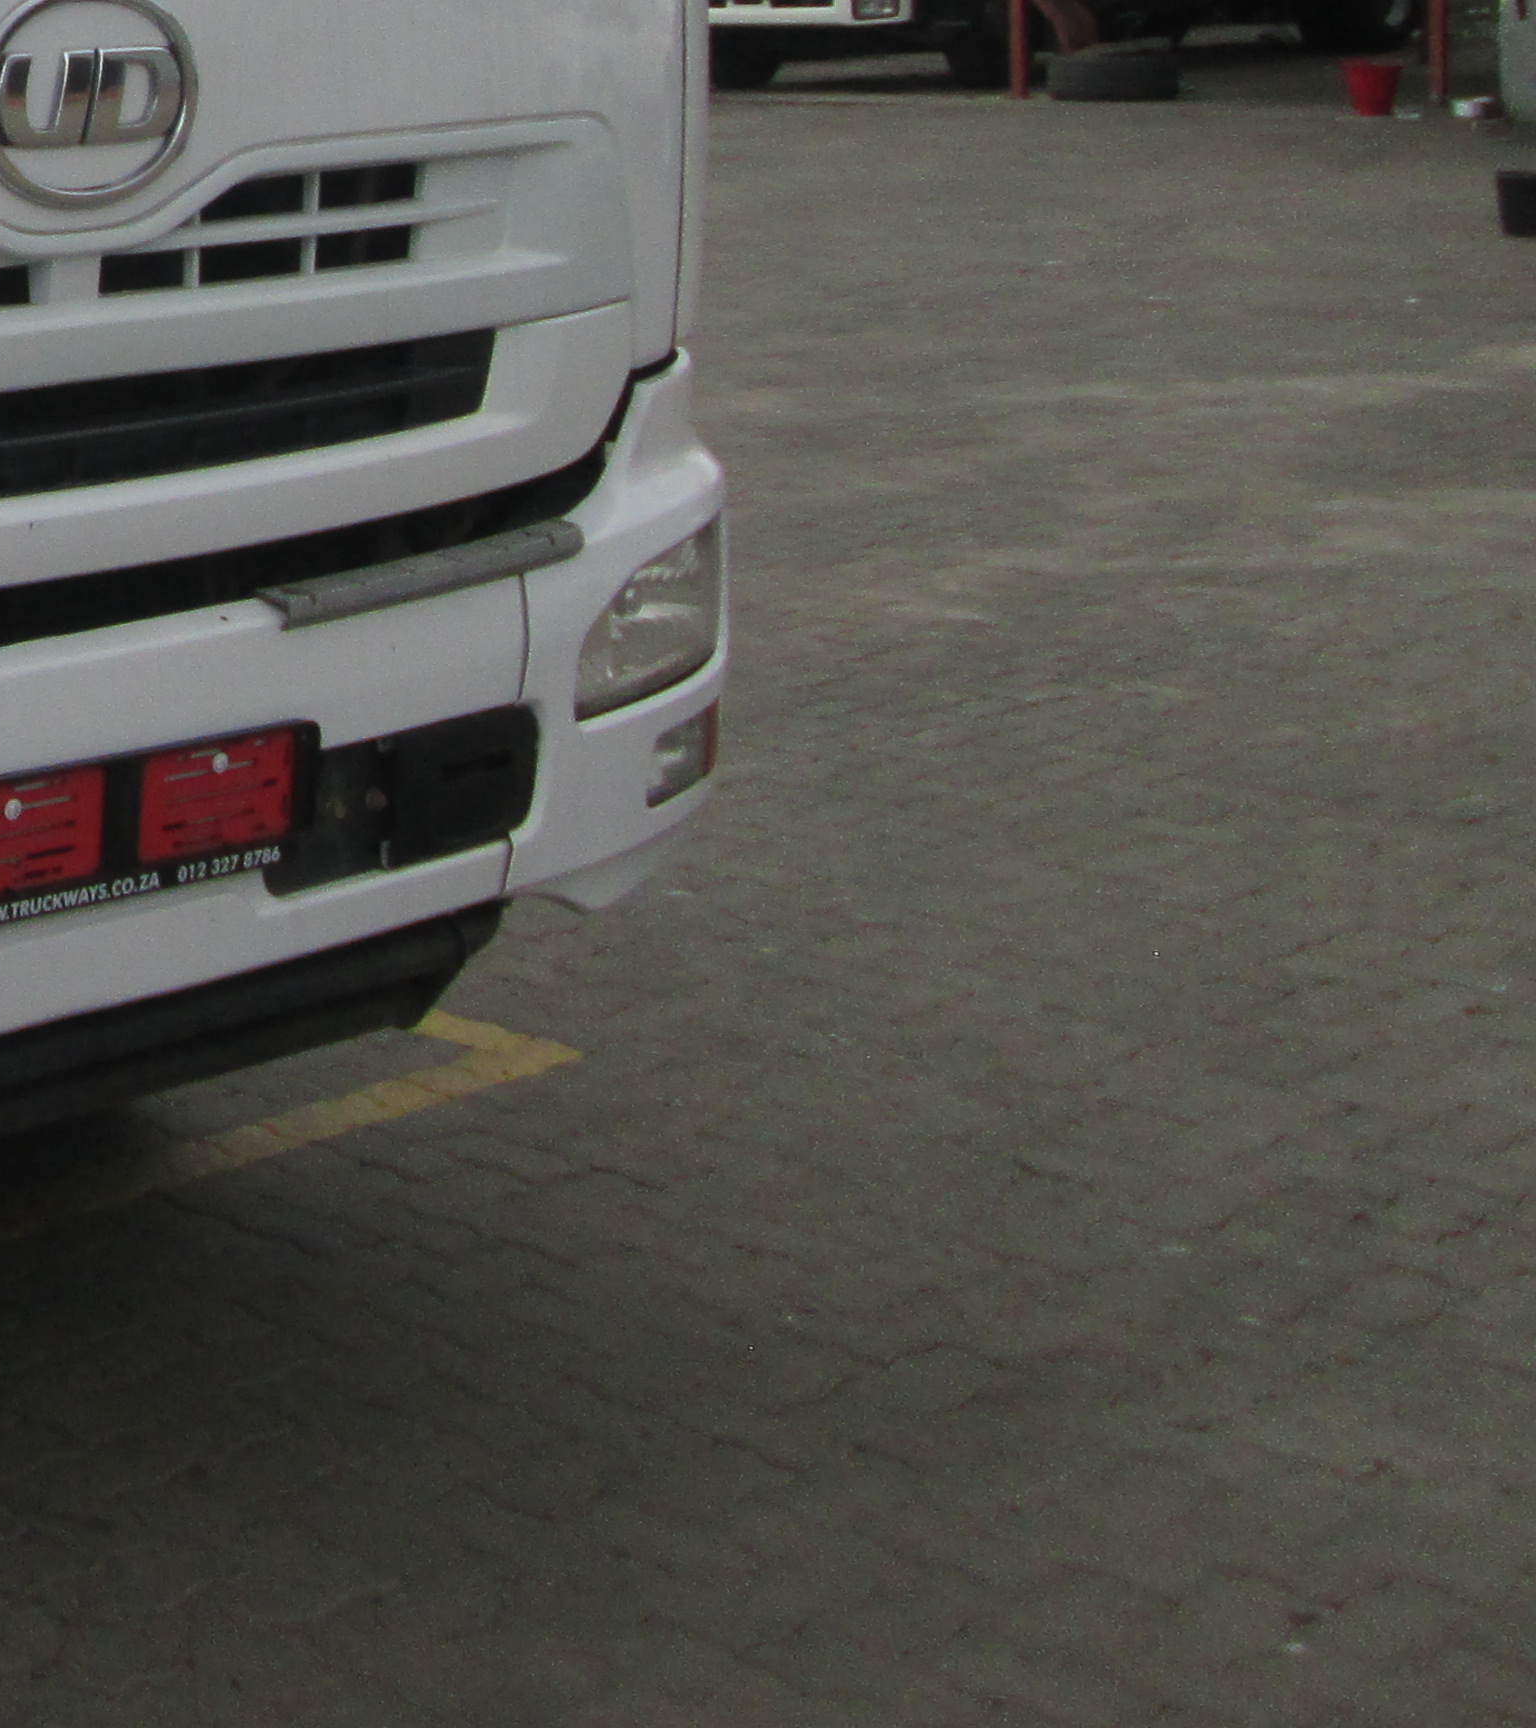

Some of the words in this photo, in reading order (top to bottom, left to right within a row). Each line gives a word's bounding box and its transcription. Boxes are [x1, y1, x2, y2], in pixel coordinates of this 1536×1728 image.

[178, 862, 207, 883] 012
[211, 854, 240, 875] 327
[243, 846, 281, 869] 8786
